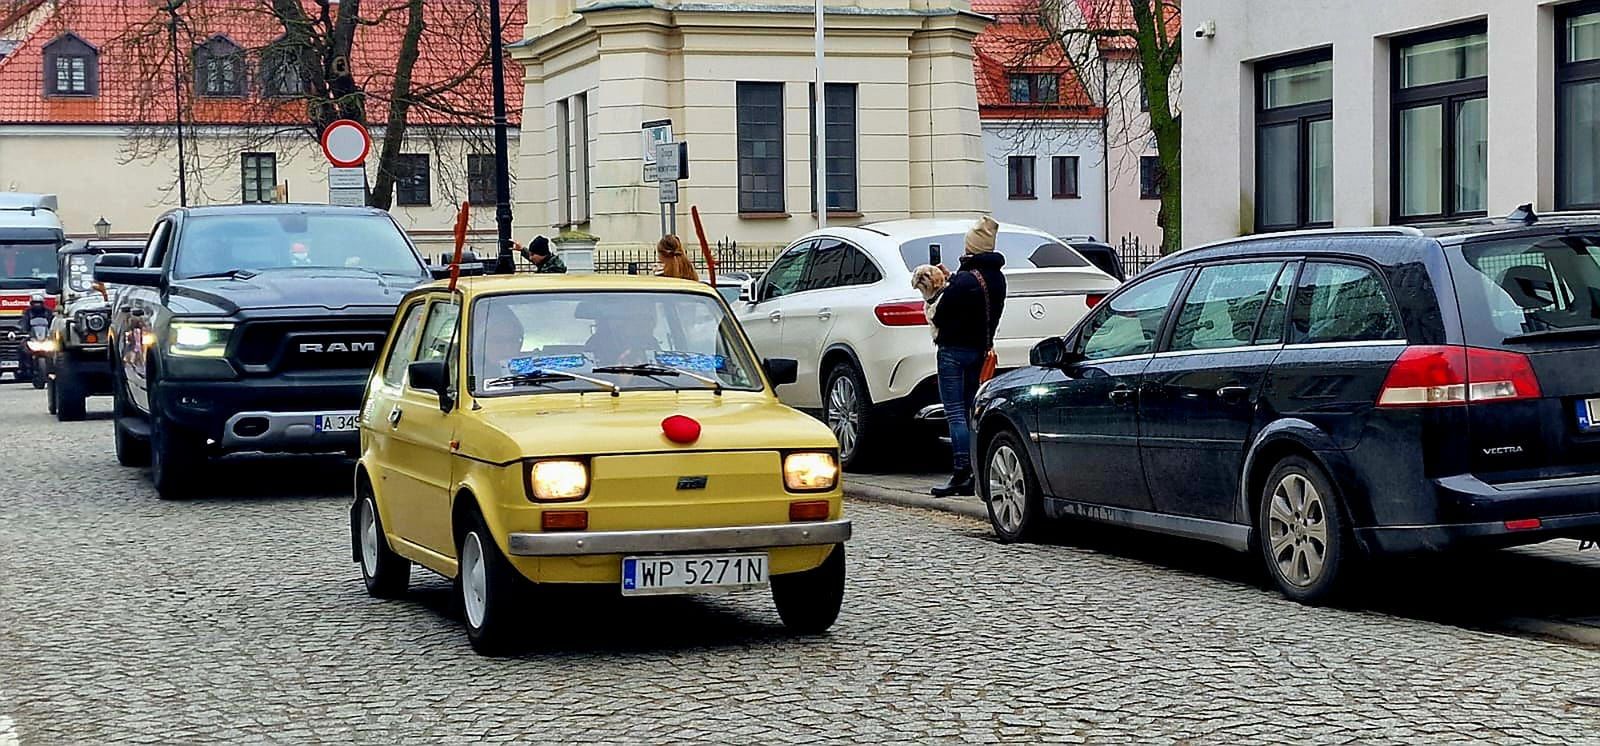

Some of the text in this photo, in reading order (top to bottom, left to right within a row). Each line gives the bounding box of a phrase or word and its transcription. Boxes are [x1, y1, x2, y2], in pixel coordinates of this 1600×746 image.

[300, 342, 375, 352] RAM
[324, 416, 333, 430] A
[1483, 446, 1523, 455] VECTRA
[642, 559, 762, 586] WP 5271N
